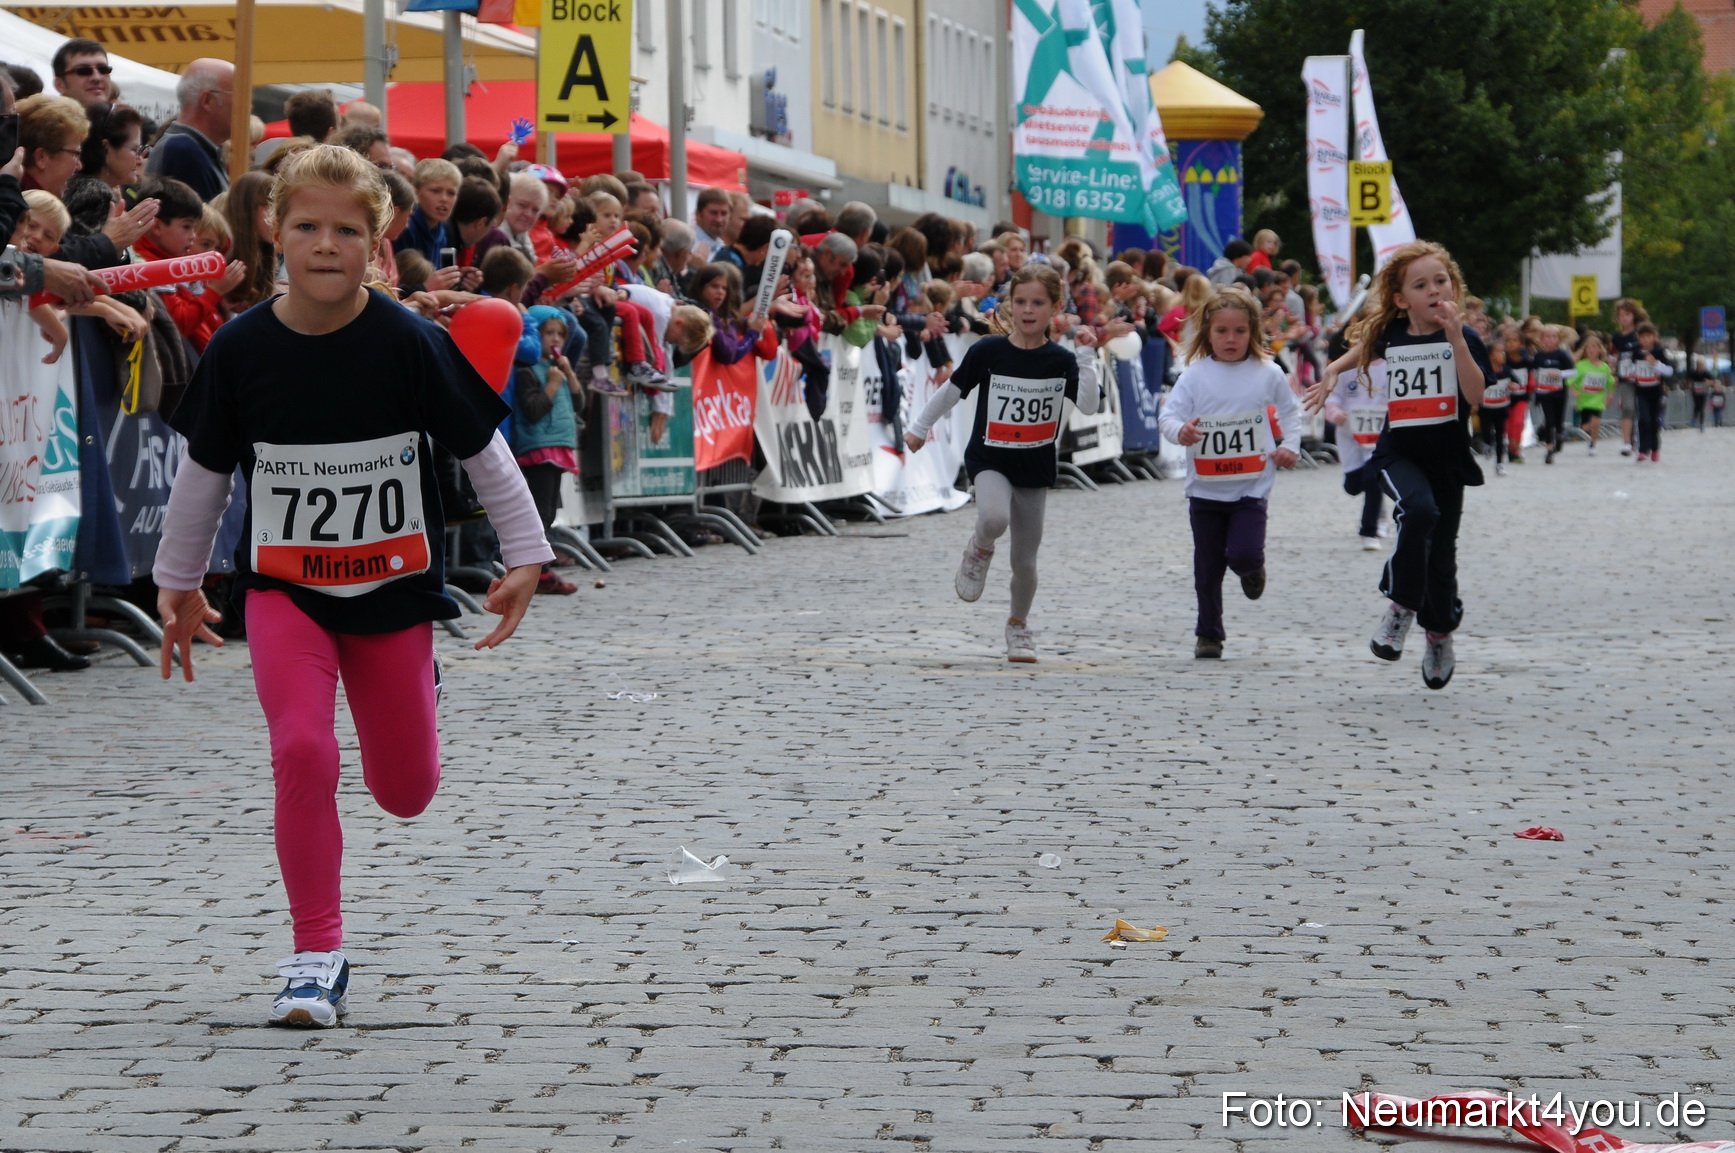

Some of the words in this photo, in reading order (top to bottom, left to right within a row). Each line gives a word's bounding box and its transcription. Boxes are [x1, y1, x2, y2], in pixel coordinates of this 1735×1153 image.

[552, 0, 621, 21] Block
[557, 34, 610, 101] A
[1354, 164, 1387, 175] Block
[1075, 189, 1126, 212] 6352
[1361, 181, 1381, 211] B
[101, 266, 149, 287] BKK
[767, 255, 780, 283] BMW
[1578, 286, 1592, 305] C
[1399, 352, 1439, 363] Neumarkt
[992, 382, 1015, 392] PARTL
[1017, 385, 1053, 394] Neumarkt
[998, 396, 1053, 423] 7395
[1216, 418, 1253, 427] Neumarkt
[1356, 417, 1384, 432] 717
[1201, 427, 1255, 456] 7041
[257, 459, 310, 476] PARTL
[314, 454, 394, 476] Neumarkt
[1215, 462, 1244, 473] Katja
[271, 478, 405, 542] 7270
[411, 520, 419, 531] W
[262, 532, 268, 542] 3
[303, 553, 388, 579] Miriam
